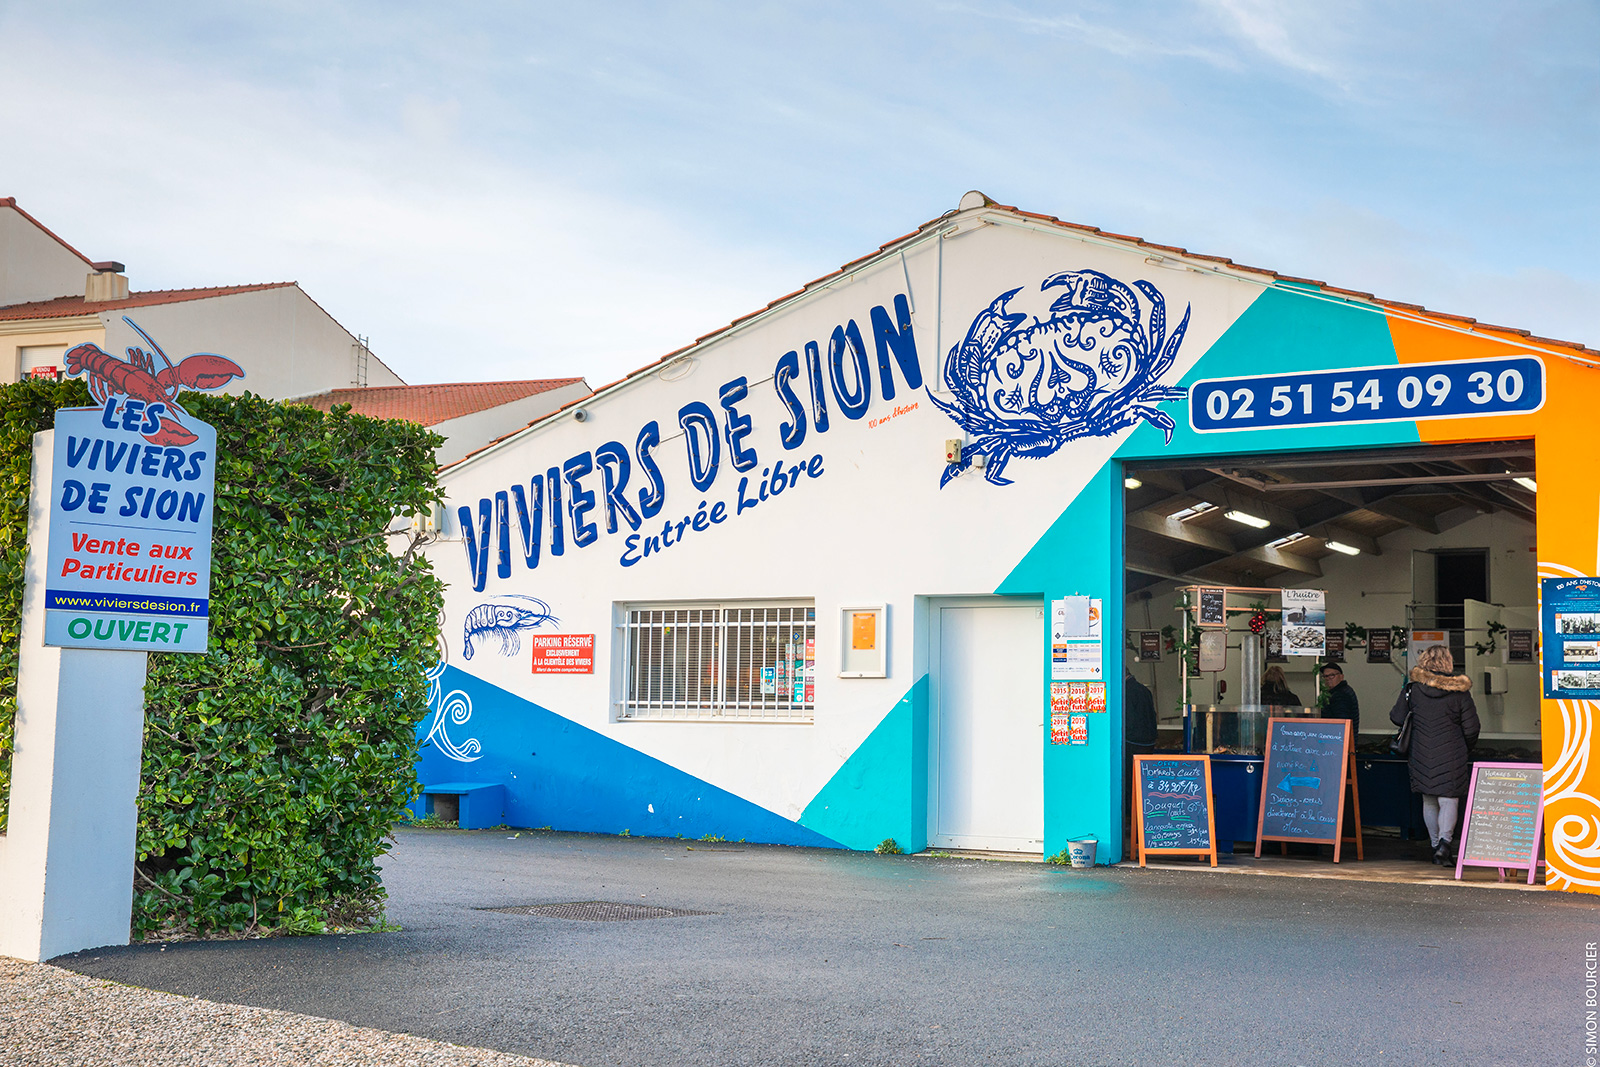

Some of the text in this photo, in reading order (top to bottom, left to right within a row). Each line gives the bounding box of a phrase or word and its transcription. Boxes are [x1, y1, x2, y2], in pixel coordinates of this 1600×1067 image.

[1206, 368, 1524, 421] 02 51 54 09 30
[102, 398, 165, 434] LES
[868, 418, 878, 429] 100
[879, 414, 891, 424] ans
[458, 294, 923, 592] VIVIERS DE SION
[66, 436, 206, 482] VIVIERS
[60, 480, 206, 523] DE SION
[620, 453, 826, 568] Entrée Libre
[72, 532, 194, 560] Vente aux
[60, 558, 198, 586] Particuliers
[54, 596, 200, 612] www.viviersdesion.fr
[68, 618, 188, 644] OUVERT
[534, 635, 592, 647] PARKING RÉSERVÉ
[1051, 698, 1068, 706] petit
[1070, 698, 1087, 706] petit
[1088, 698, 1105, 706] petit
[1141, 762, 1175, 776] Homards
[1144, 799, 1186, 816] Bouquet
